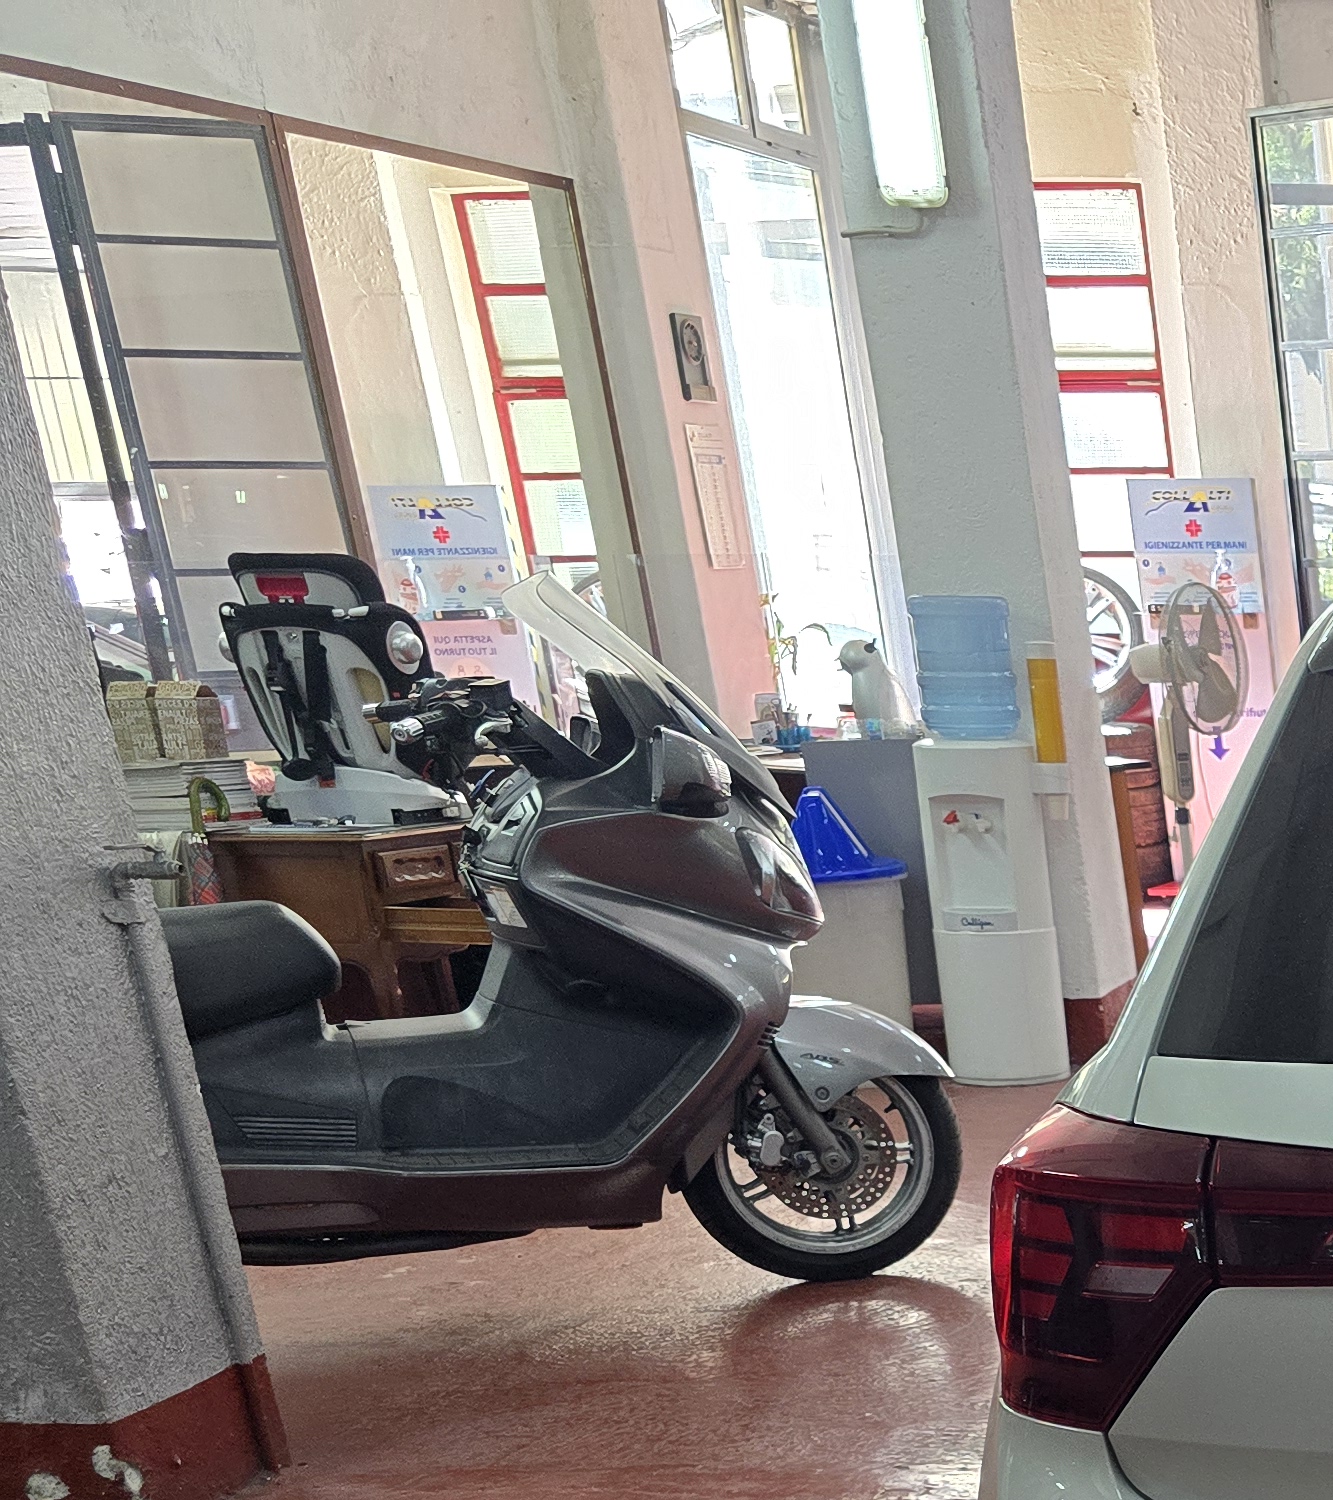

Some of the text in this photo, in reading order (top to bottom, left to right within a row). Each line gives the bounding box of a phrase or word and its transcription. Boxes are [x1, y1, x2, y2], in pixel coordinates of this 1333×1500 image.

[1144, 541, 1248, 550] IGIENIZZANTE PER MANI
[800, 1053, 842, 1065] ABS
